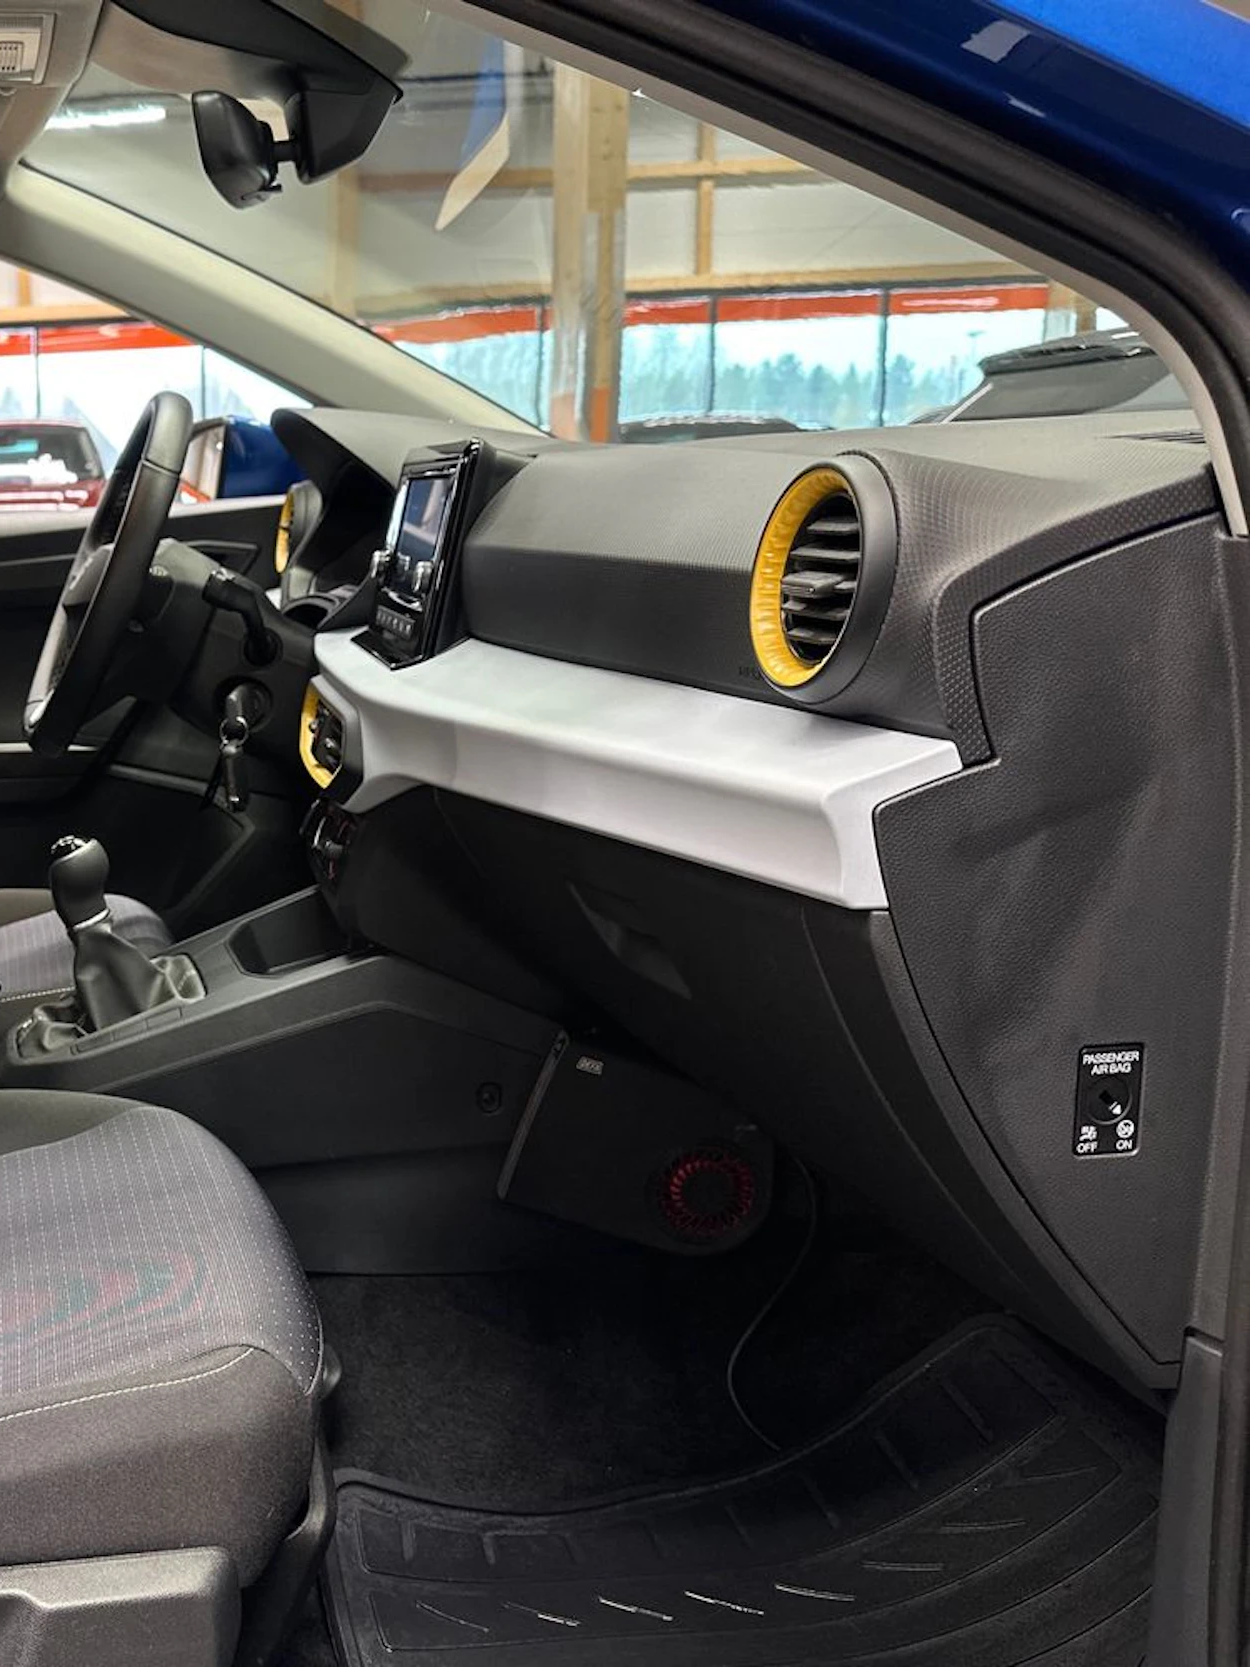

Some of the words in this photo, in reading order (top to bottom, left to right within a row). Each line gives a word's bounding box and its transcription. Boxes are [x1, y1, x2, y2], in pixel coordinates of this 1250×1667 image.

[1082, 1051, 1139, 1065] PASSENGER
[1091, 1064, 1108, 1075] AIR
[1110, 1062, 1131, 1074] BAG
[1076, 1142, 1098, 1153] OFF
[1116, 1140, 1132, 1150] ON
